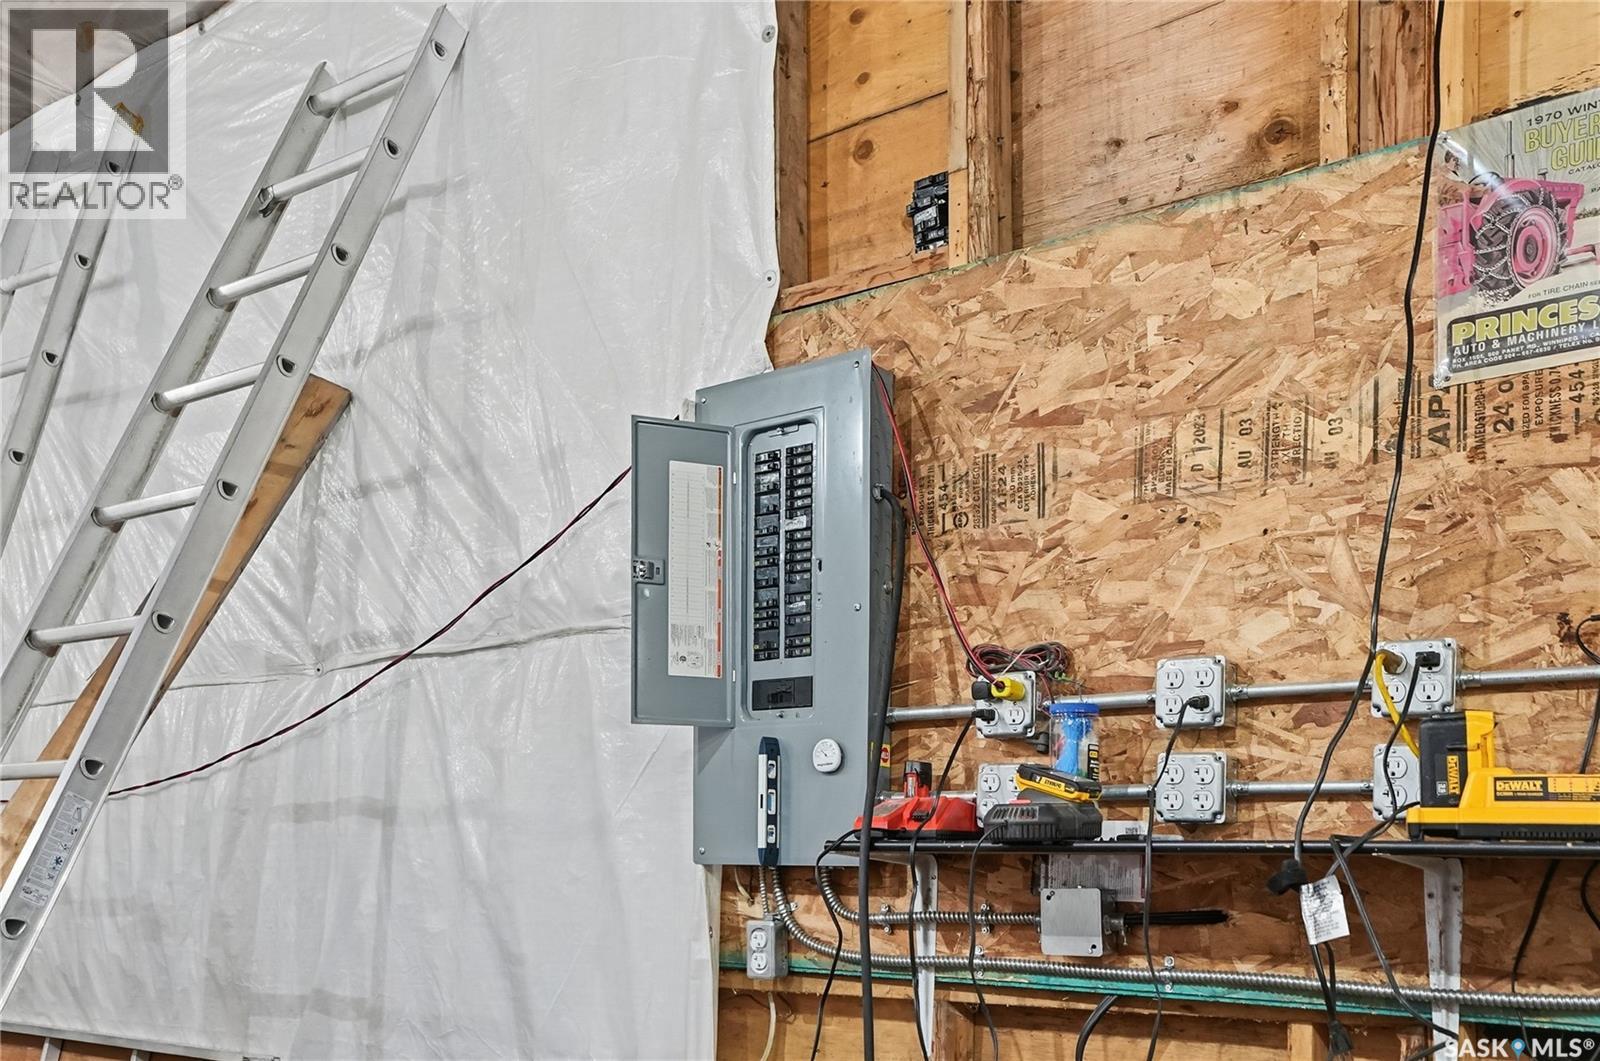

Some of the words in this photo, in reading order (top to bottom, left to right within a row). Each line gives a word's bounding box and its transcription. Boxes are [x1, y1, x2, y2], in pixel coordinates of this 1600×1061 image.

[1527, 110, 1563, 126] 1970
[1528, 291, 1541, 299] FOR
[1543, 286, 1562, 296] TIRE
[1563, 281, 1589, 292] CHAIN
[1452, 294, 1600, 347] PRINCES
[1453, 342, 1486, 357] AUTO
[1491, 339, 1501, 349] &
[1507, 322, 1585, 346] MACHINERY
[1543, 335, 1579, 347] WINNIPEG
[1464, 359, 1482, 367] AREA
[1483, 355, 1503, 363] CODE
[1558, 341, 1580, 349] TELEX
[1535, 369, 1543, 426] EXPOSURE
[1568, 369, 1585, 404] 454
[1522, 392, 1530, 411] FOR
[1549, 386, 1562, 439] THICKNESS
[1192, 413, 1206, 445] 2023
[1238, 418, 1253, 437] 03
[1327, 417, 1344, 436] 03
[1493, 401, 1514, 434] 24
[1522, 412, 1530, 439] SIZED
[1271, 411, 1281, 470] STRENGTH
[1474, 423, 1486, 450] RATED
[1237, 450, 1252, 470] AU
[1165, 470, 1173, 495] MADE
[938, 483, 948, 511] 454
[927, 496, 935, 536] THICKNESS
[1496, 780, 1543, 792] DEWALT
